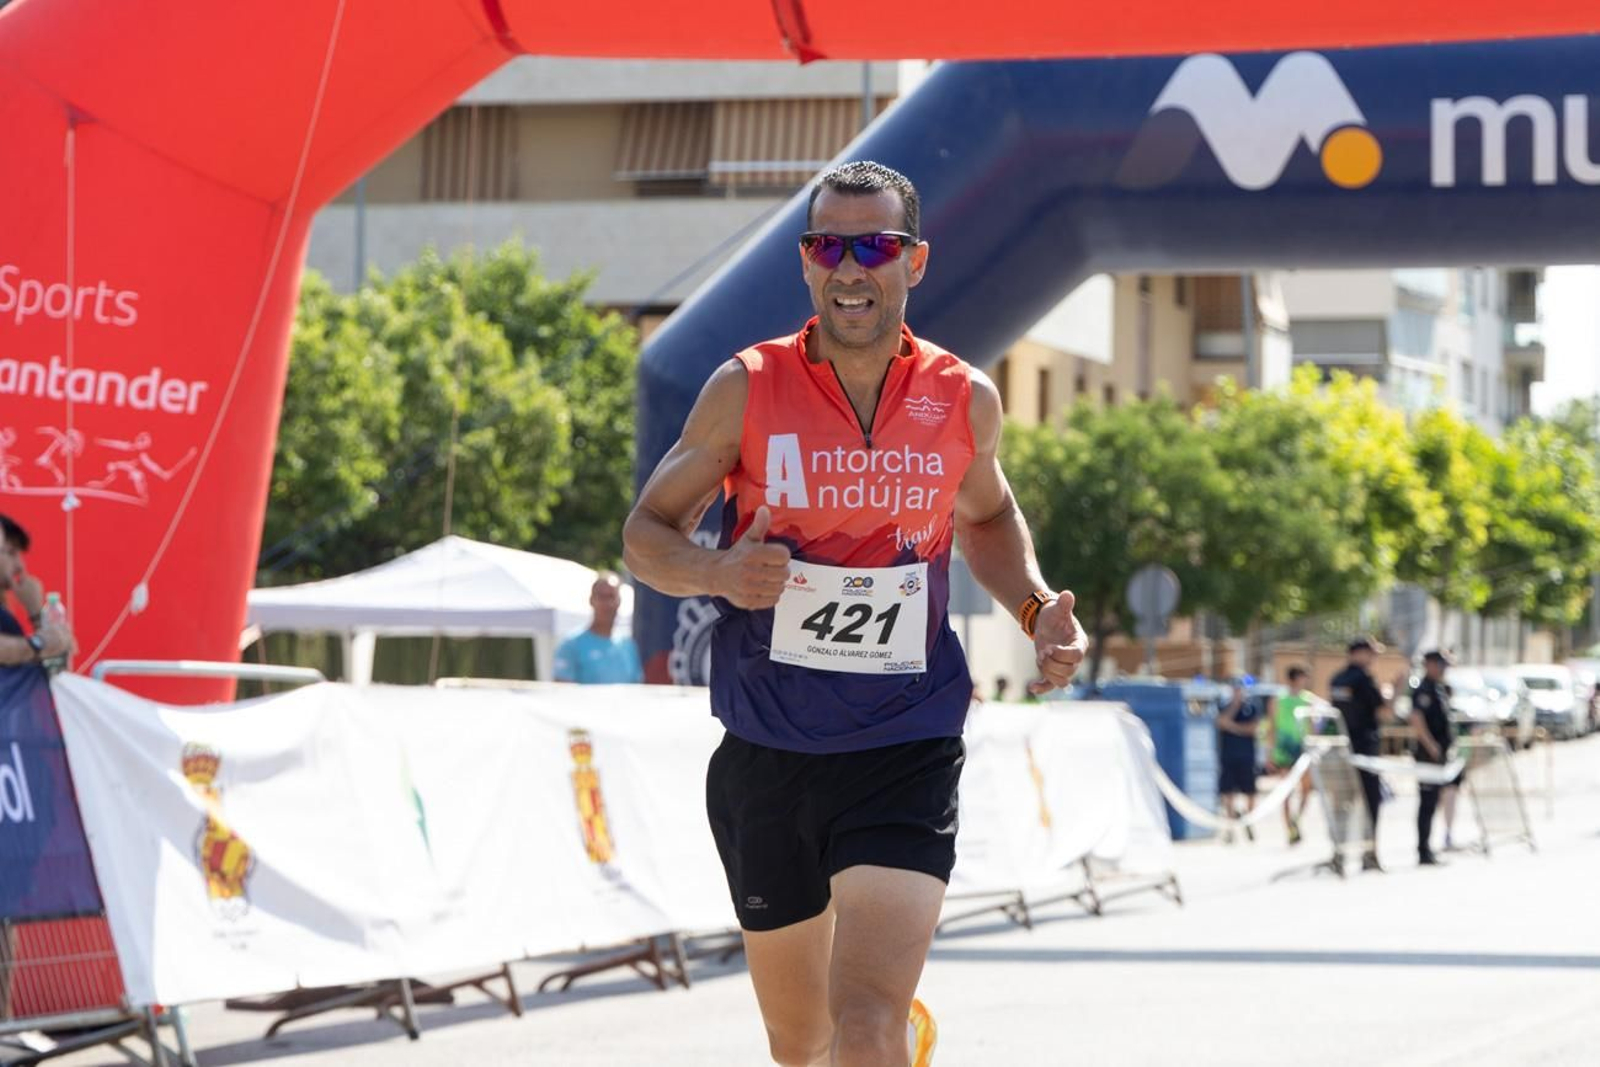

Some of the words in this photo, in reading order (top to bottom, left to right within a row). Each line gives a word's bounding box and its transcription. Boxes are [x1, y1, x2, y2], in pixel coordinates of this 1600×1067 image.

[0, 264, 139, 327] Sports
[801, 601, 901, 645] 421
[807, 645, 838, 656] GONZALO
[0, 742, 35, 822] ol
